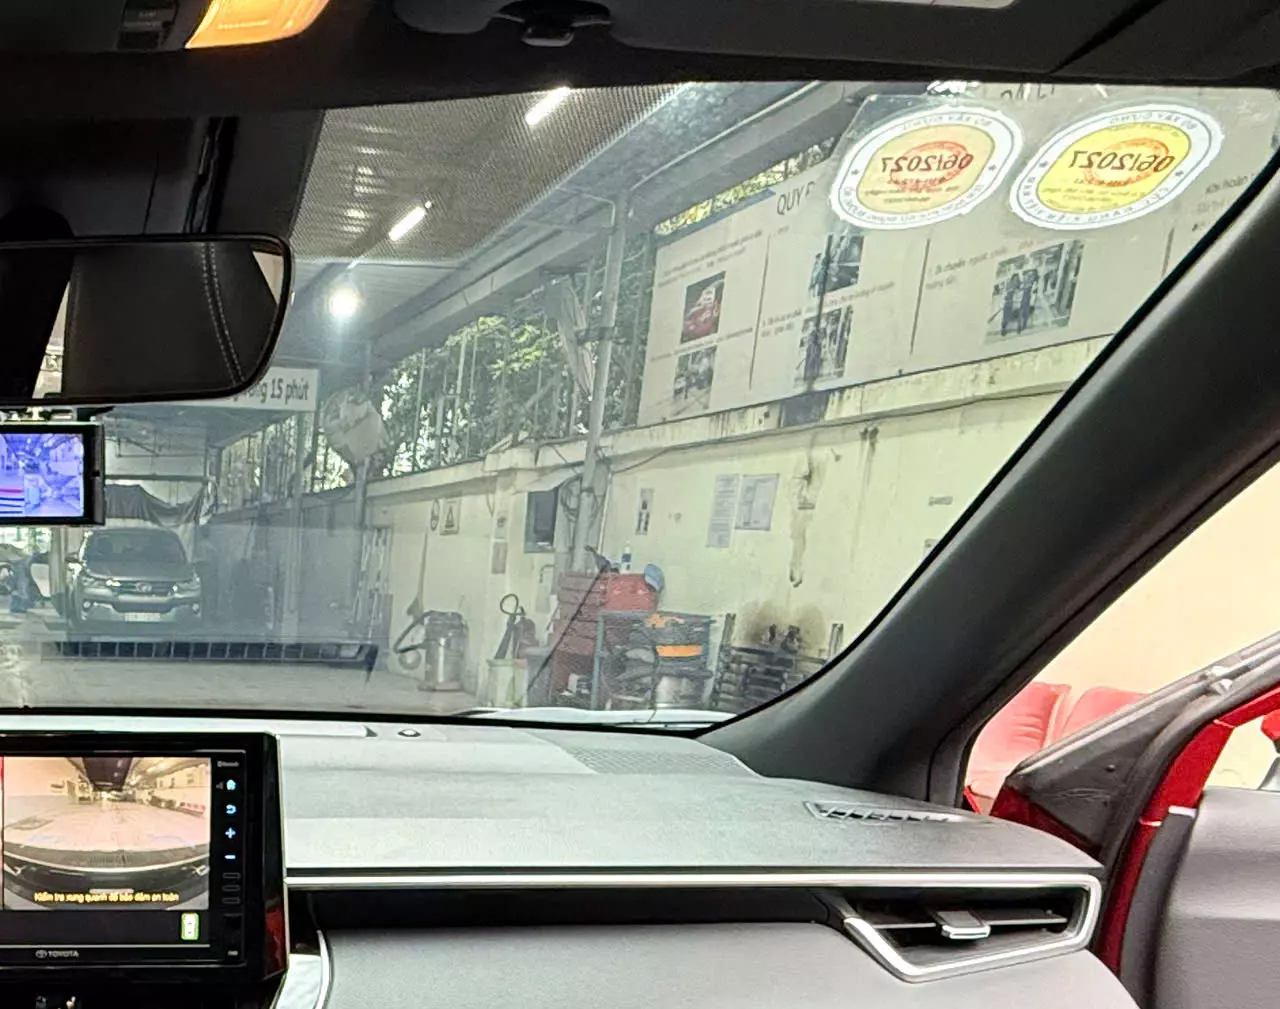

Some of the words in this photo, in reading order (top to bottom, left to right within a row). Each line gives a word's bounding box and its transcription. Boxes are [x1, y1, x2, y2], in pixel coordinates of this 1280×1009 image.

[270, 378, 283, 399] 15
[285, 378, 309, 405] phút
[48, 950, 79, 958] TOYOTA
